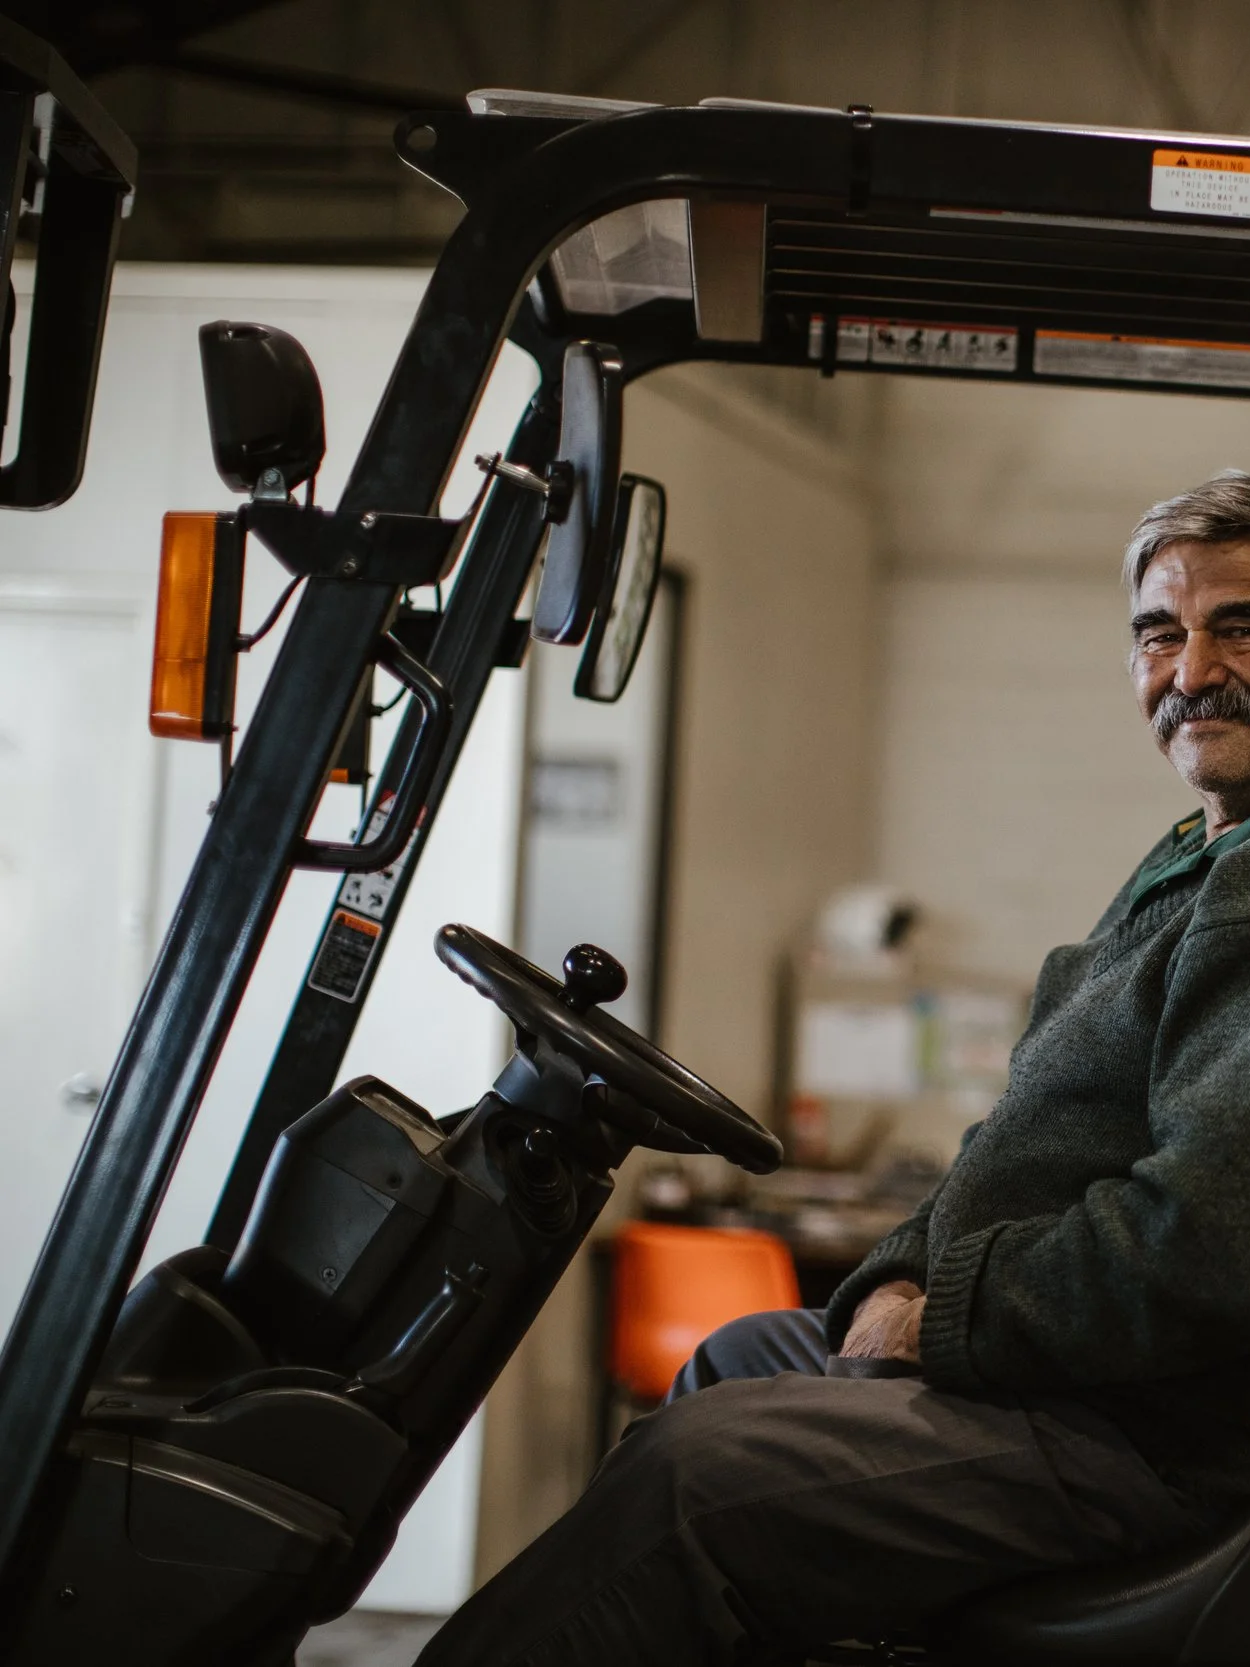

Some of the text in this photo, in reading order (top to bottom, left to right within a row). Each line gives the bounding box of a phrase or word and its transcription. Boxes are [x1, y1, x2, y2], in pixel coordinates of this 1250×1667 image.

[1194, 158, 1244, 171] WARNING
[1165, 169, 1213, 180] OPERATION
[1181, 180, 1239, 192] THIS DEVICE
[1170, 190, 1180, 198] IN
[1186, 191, 1211, 201] PLACE
[1217, 194, 1233, 202] MAY
[1185, 201, 1233, 211] HAZARDOUS
